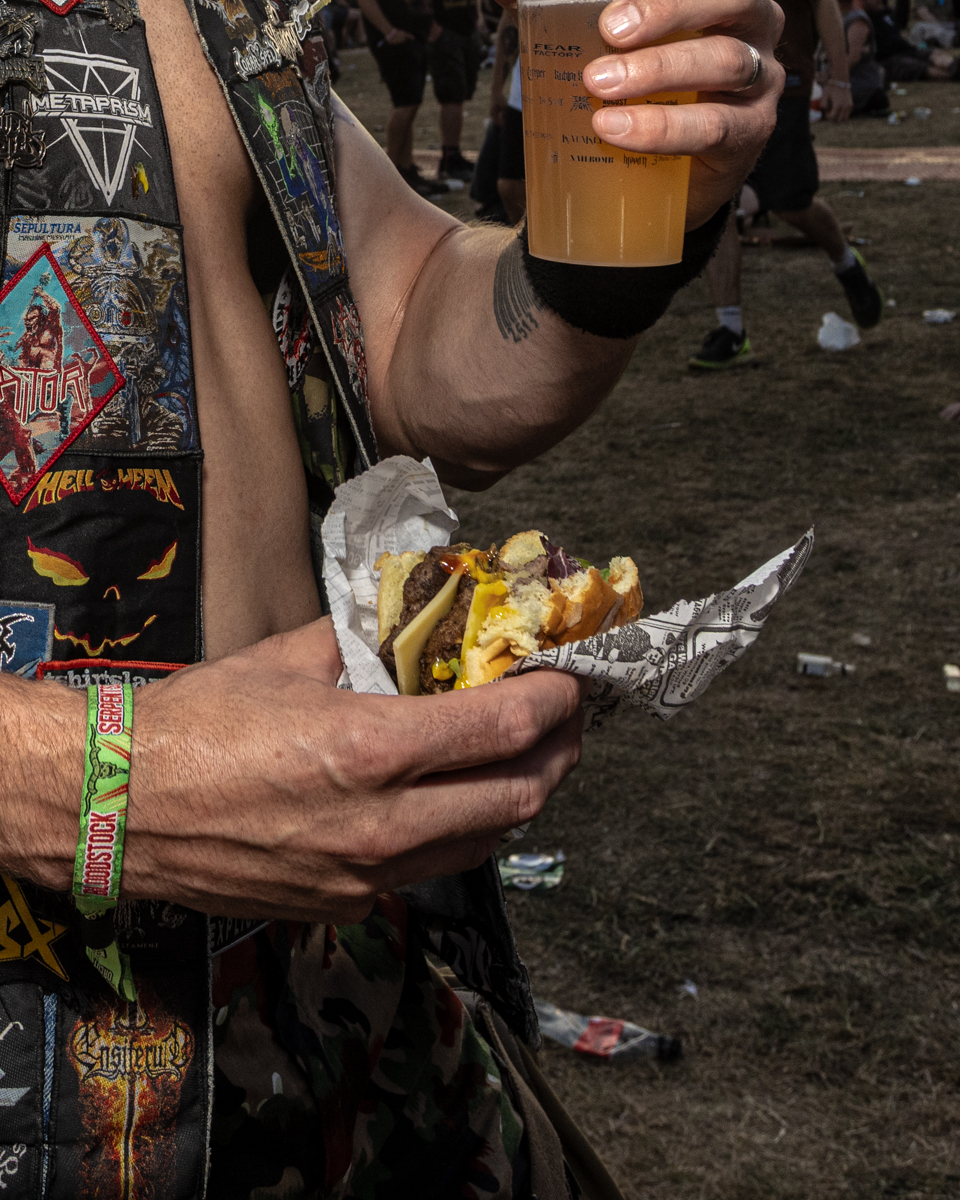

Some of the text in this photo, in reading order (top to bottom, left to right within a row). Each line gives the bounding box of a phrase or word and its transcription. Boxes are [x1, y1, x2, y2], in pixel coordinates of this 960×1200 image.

[533, 43, 581, 51] FEAR
[533, 50, 583, 58] FACTORY
[29, 91, 153, 128] METAPRISM
[13, 222, 82, 235] SEPULTURA
[44, 670, 162, 689] tshirtsla
[82, 810, 118, 896] BLOODSTOCK
[210, 918, 256, 948] EXPLI
